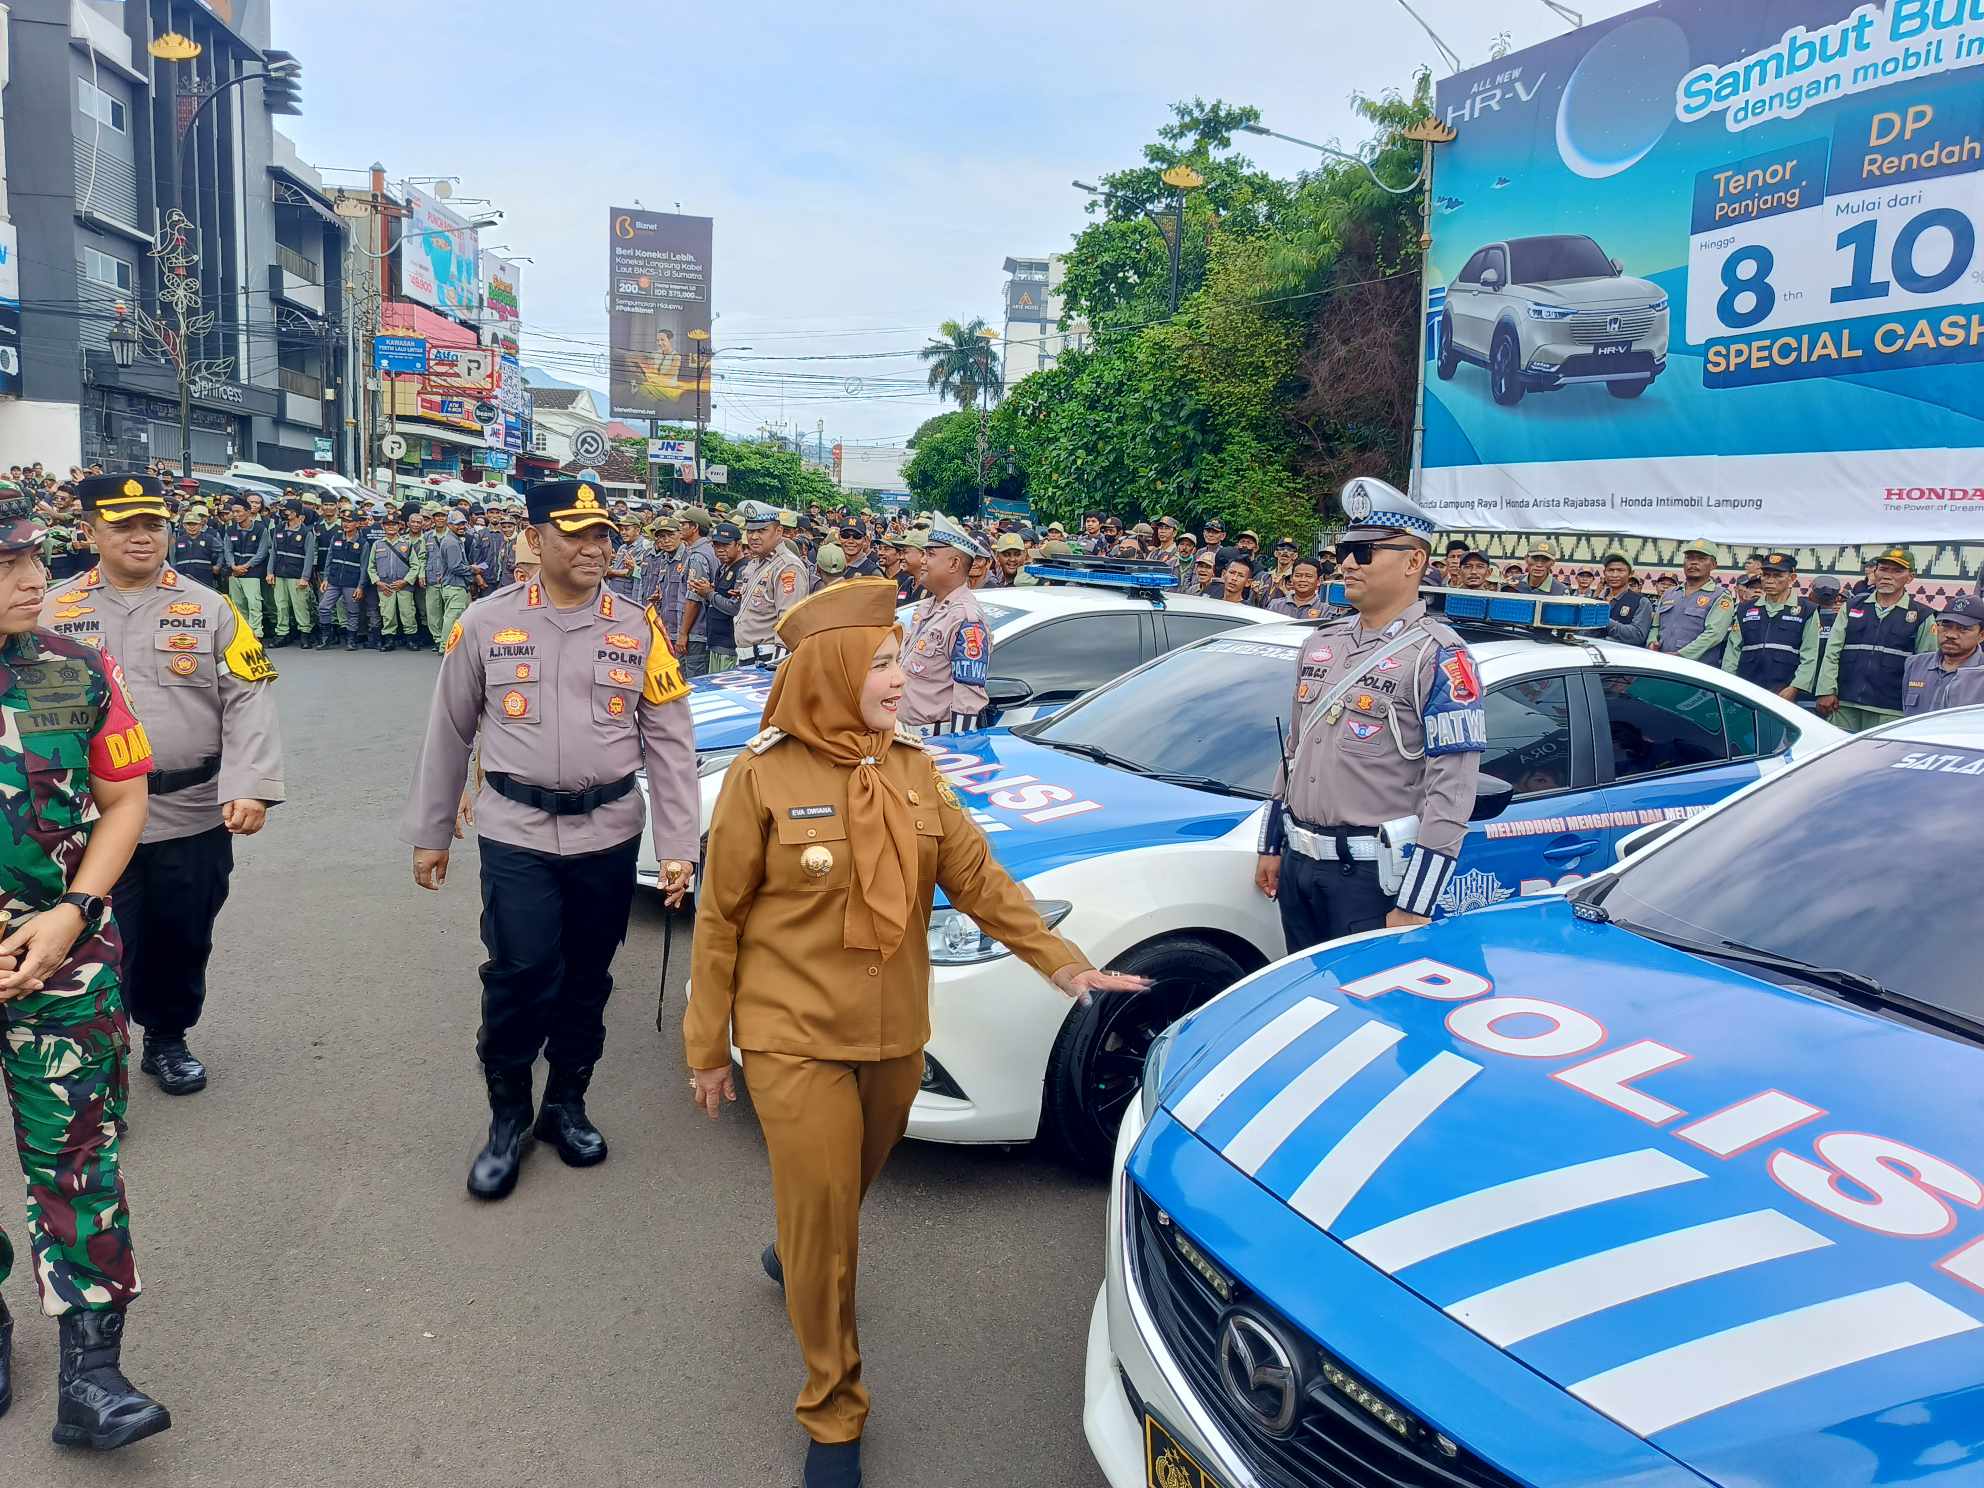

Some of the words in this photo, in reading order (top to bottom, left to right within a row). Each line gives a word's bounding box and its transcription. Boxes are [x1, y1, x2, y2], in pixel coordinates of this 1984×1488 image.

[1683, 13, 1873, 115] Sambut
[1470, 78, 1491, 95] ALL
[1495, 66, 1523, 85] NEW
[1733, 72, 1841, 125] dengan
[1852, 38, 1943, 85] mobil
[1446, 72, 1547, 128] HR-V
[1869, 104, 1934, 148] DP
[1862, 135, 1982, 179] Rendah
[1713, 159, 1798, 198] Tenor
[1715, 187, 1801, 222] Panjang
[1835, 197, 1882, 217] Mulai
[1887, 190, 1923, 209] dari
[636, 221, 657, 230] Biznet
[1699, 236, 1736, 252] Hingga
[616, 248, 634, 256] Beri
[635, 250, 669, 260] Koneksi
[1829, 207, 1976, 304] 10
[616, 257, 644, 266] Koneksi
[646, 260, 681, 271] Langsung
[616, 265, 632, 273] Laut
[619, 283, 638, 293] 200
[1716, 244, 1776, 330] 8
[1783, 289, 1803, 302] thn
[434, 350, 463, 362] Alfa
[1598, 345, 1628, 355] HR-V
[1705, 328, 1863, 374] SPECIAL
[201, 380, 242, 403] princess
[658, 441, 685, 452] JNE
[1884, 487, 1984, 501] HONDA
[1440, 500, 1475, 510] Lampung
[1478, 498, 1498, 509] Raya
[1505, 499, 1530, 509] Honda
[1532, 498, 1560, 508] Arista
[1563, 497, 1607, 509] Rajabasa
[1620, 497, 1653, 508] Honda
[1656, 496, 1702, 507] Intimobil
[1707, 496, 1763, 510] Lampung
[159, 619, 207, 629] POLRI
[597, 650, 642, 666] POLRI
[1356, 674, 1397, 694] POLRI
[29, 713, 60, 728] TNI
[69, 712, 90, 726] AD
[1484, 817, 1566, 839] MELINDUNGI
[1565, 810, 1638, 833] MENGAYOMI
[1638, 808, 1665, 824] DAN
